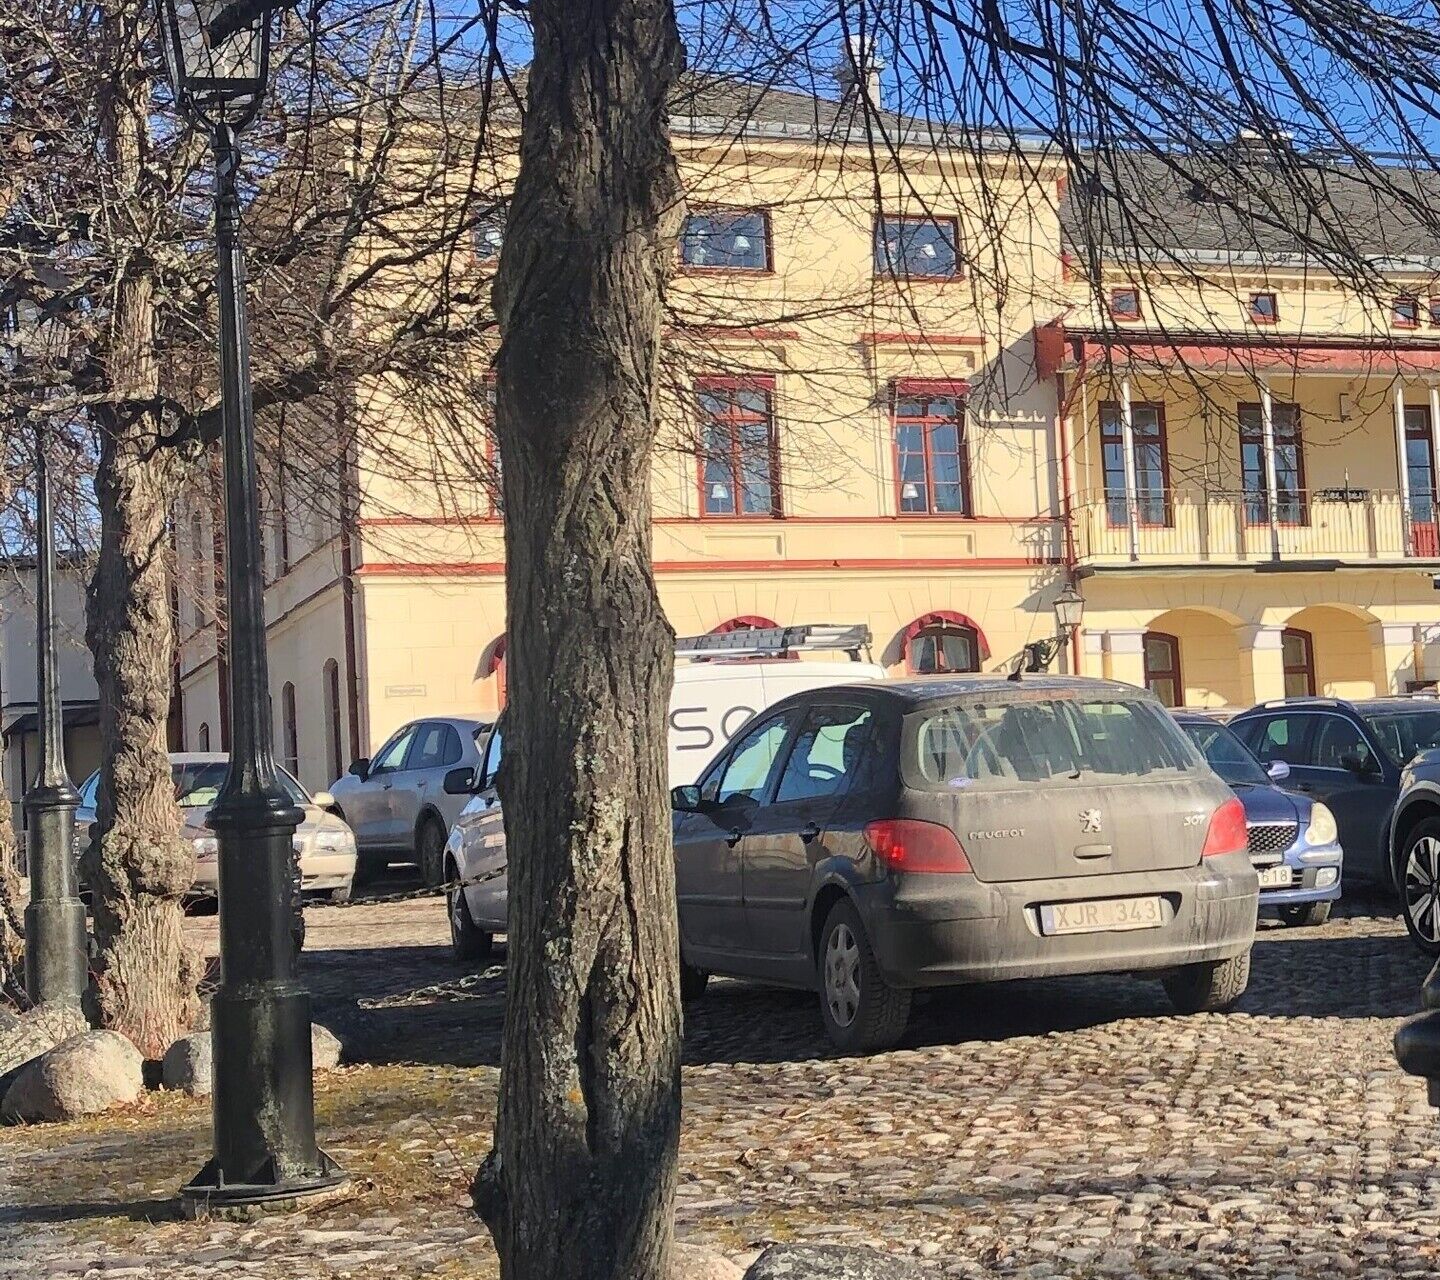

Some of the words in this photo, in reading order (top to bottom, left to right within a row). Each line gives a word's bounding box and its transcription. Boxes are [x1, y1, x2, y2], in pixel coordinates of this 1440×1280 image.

[1183, 814, 1206, 826] 307
[968, 828, 1026, 840] PEUGEOT
[1055, 905, 1099, 928] XJR
[1115, 900, 1157, 922] 343
